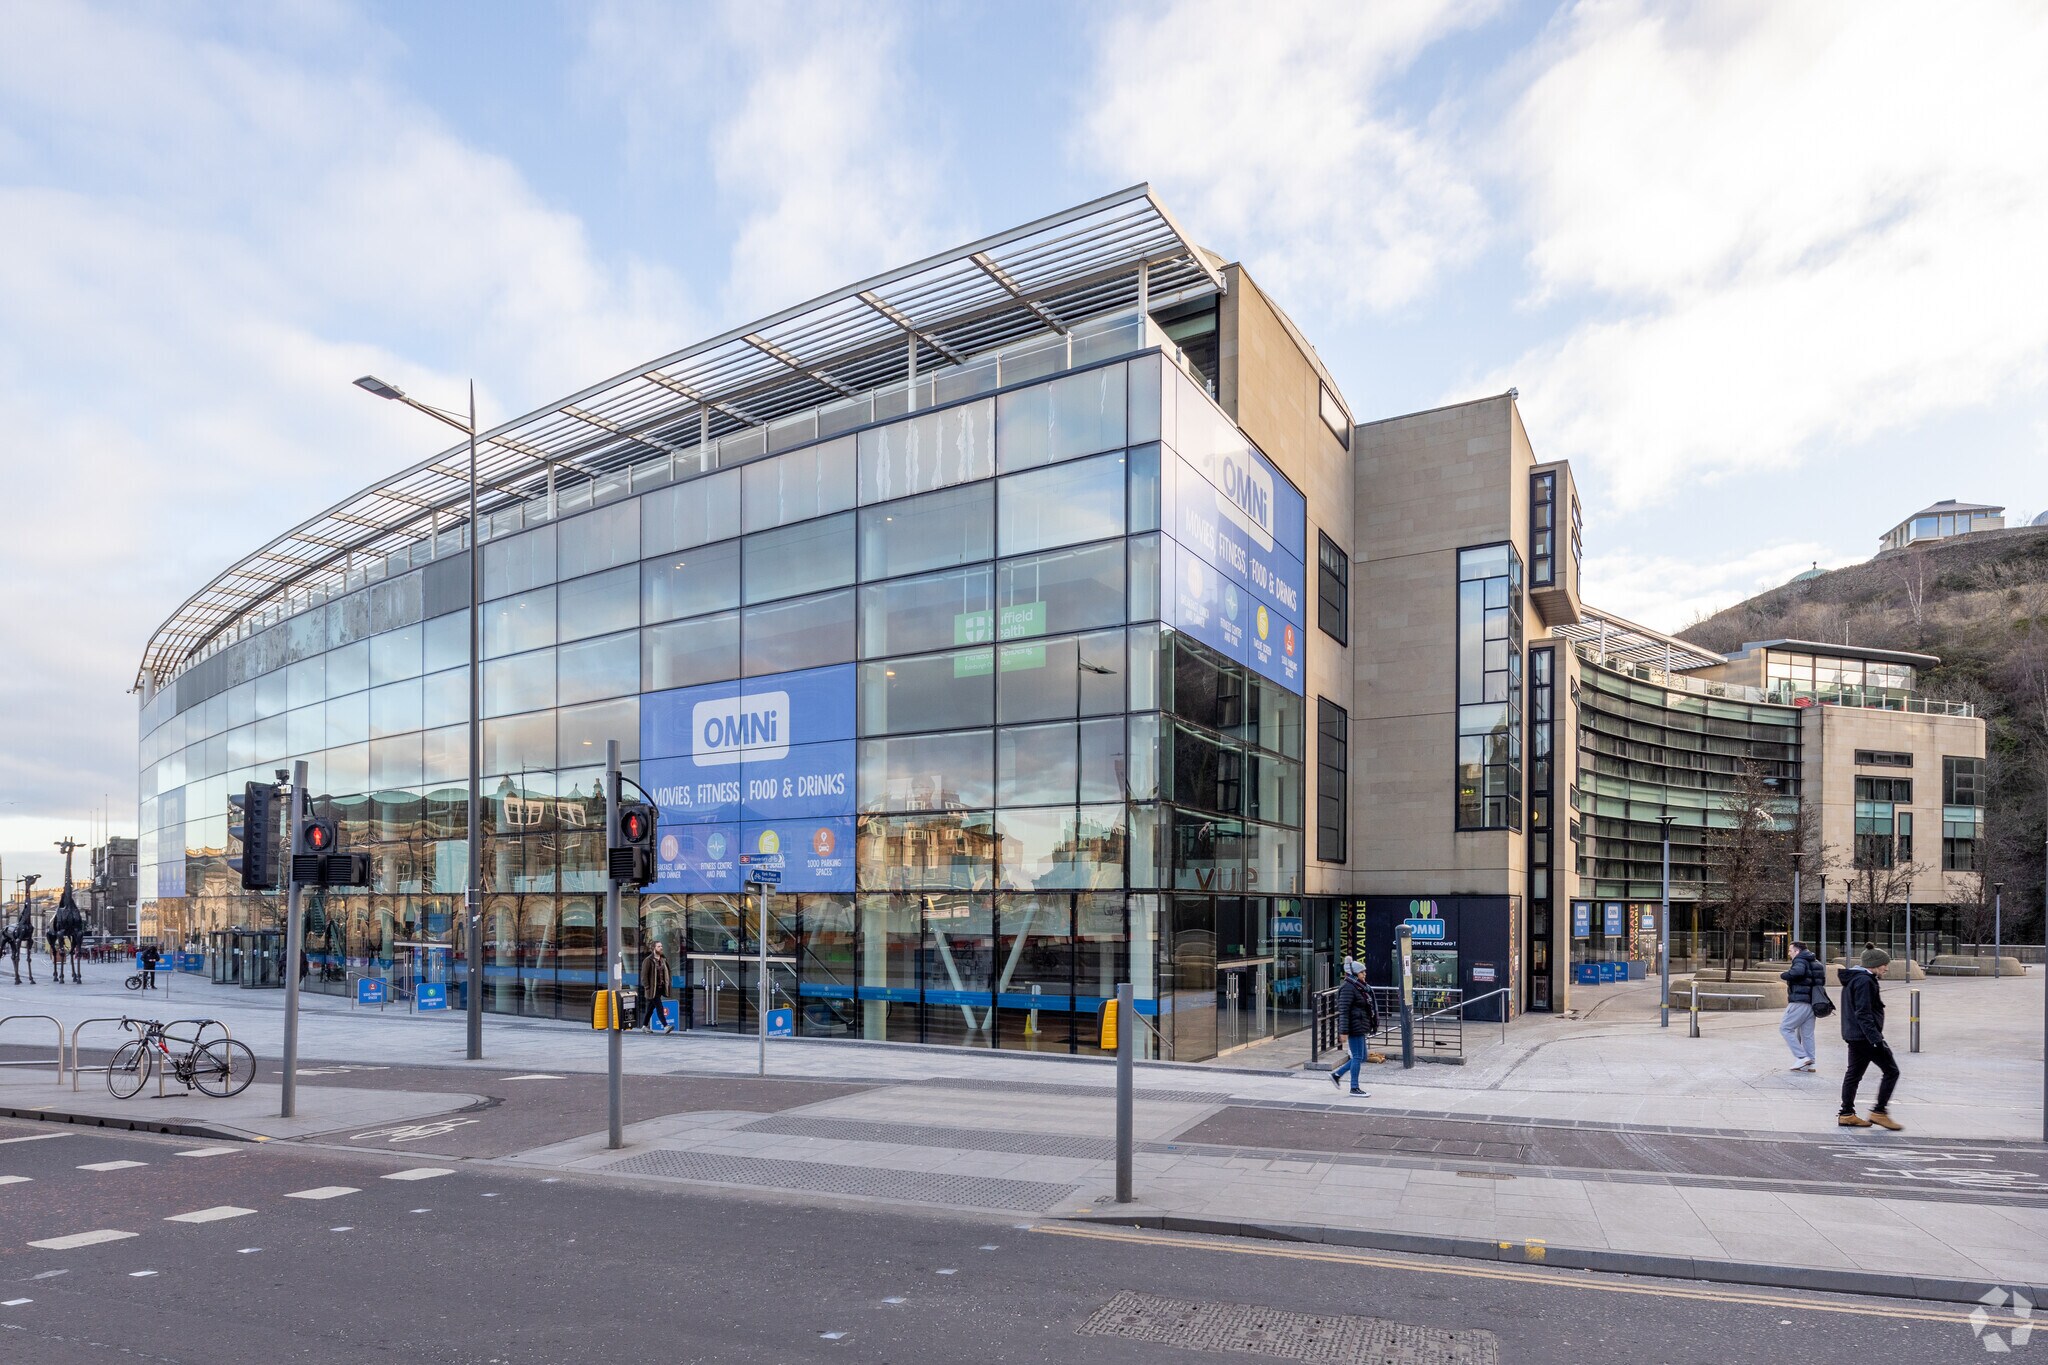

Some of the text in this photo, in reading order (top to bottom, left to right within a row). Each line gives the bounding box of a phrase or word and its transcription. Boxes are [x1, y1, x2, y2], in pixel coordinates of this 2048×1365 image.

[1223, 456, 1267, 529] OMNi
[1252, 558, 1268, 589] FOOD
[1268, 571, 1275, 595] &
[704, 710, 777, 748] OMNi
[750, 779, 777, 800] FOOD
[782, 777, 793, 798] &
[657, 863, 673, 871] EAKFAST,
[700, 862, 733, 870] FITNESS CENTRE
[706, 870, 726, 878] AND POOL
[807, 859, 842, 868] 1000 PARKING
[815, 867, 833, 876] SPACES
[1195, 867, 1259, 892] vue
[1356, 900, 1366, 966] AVAILABLE
